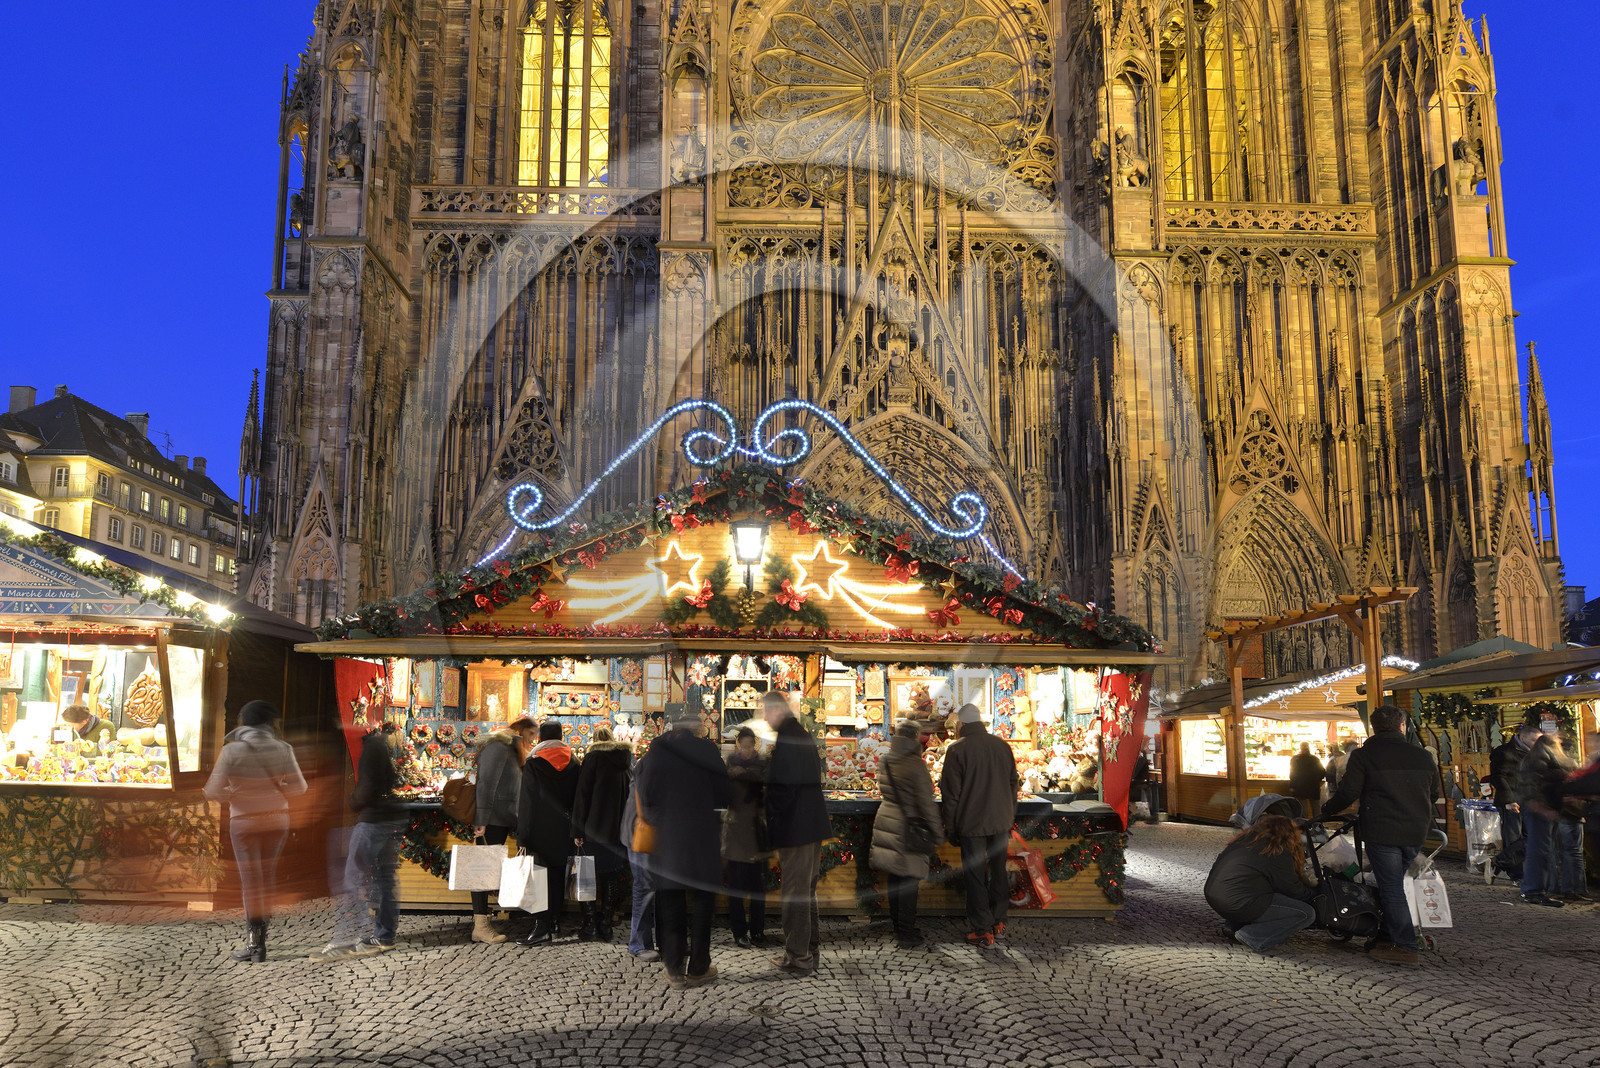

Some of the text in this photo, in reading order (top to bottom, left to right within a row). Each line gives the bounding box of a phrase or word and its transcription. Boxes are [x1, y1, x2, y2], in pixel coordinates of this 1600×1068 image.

[29, 559, 77, 586] Bonnes Fêtes
[7, 589, 43, 598] Marché
[45, 589, 57, 598] de
